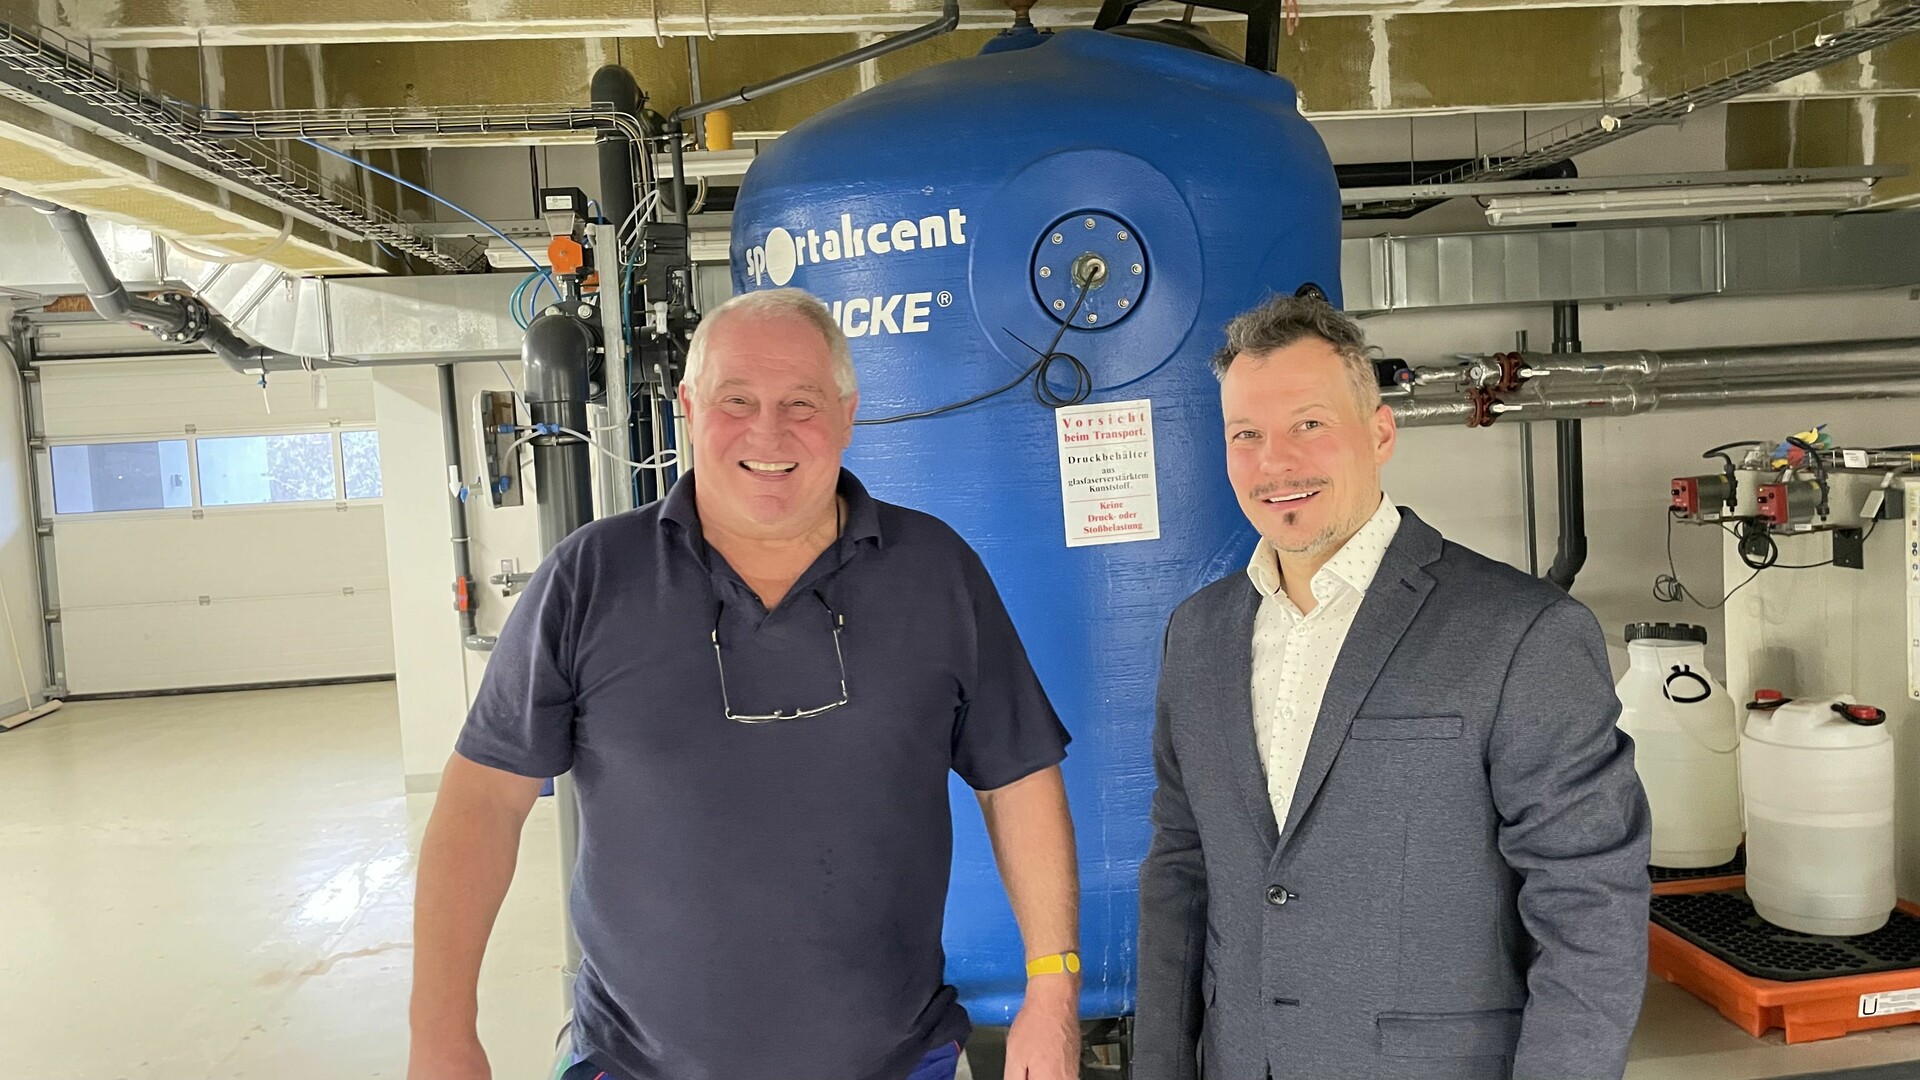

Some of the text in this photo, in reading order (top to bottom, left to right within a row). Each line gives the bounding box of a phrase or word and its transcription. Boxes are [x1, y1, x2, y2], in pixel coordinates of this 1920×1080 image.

[1062, 412, 1145, 428] Vorsicht
[1064, 428, 1146, 442] beim Transport.
[1068, 450, 1148, 464] Druckbehälter
[1068, 473, 1149, 486] glasfaserverstärktem
[1100, 501, 1124, 510] Keine
[1088, 511, 1137, 522] Druck- oder
[1083, 522, 1143, 534] Stoßbelastung
